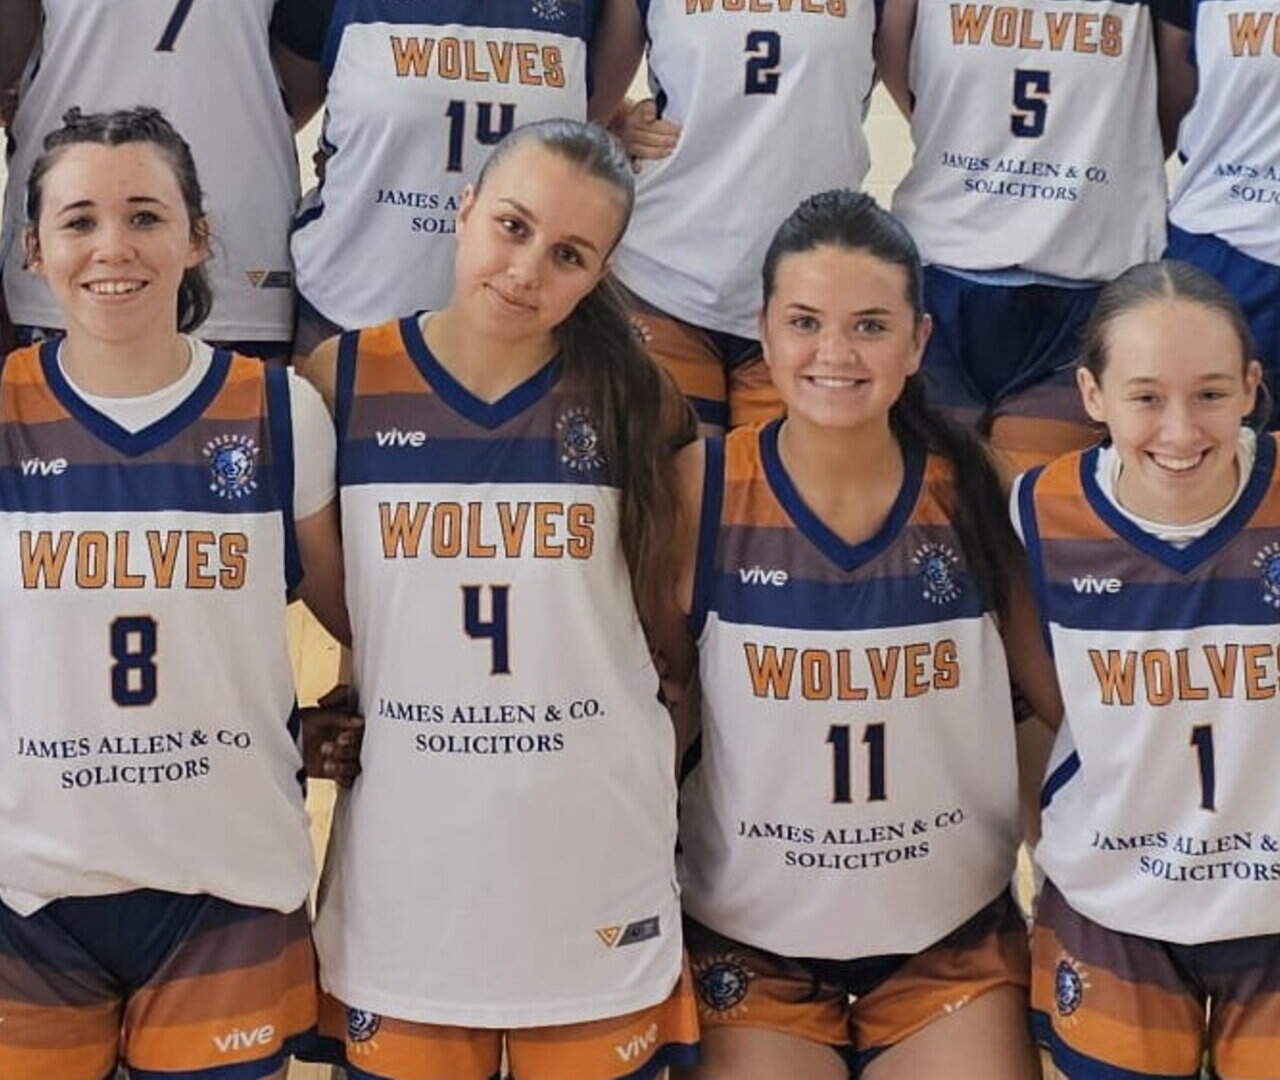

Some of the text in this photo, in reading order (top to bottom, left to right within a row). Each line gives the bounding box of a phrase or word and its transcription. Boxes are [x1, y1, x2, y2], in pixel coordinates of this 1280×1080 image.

[950, 3, 1123, 57] WOLVES
[390, 35, 566, 88] WOLVES
[745, 30, 781, 95] 2
[1010, 69, 1051, 138] 5
[941, 151, 1109, 184] JAMES ALLEN & CO.
[375, 189, 438, 210] JAMES
[963, 179, 1078, 201] SOLICITORS
[375, 429, 426, 447] vive
[21, 455, 68, 476] vive
[378, 502, 596, 560] WOLVES
[19, 530, 249, 589] WOLVES
[739, 566, 789, 586] vive
[1073, 574, 1122, 595] vive
[460, 584, 511, 676] 4
[110, 615, 158, 708] 8
[743, 639, 960, 701] WOLVES
[379, 699, 605, 724] JAMES ALLEN & CO.
[18, 737, 91, 759] JAMES
[98, 731, 184, 754] ALLEN
[190, 729, 208, 747] &
[415, 734, 564, 754] SOLICITORS
[61, 757, 210, 789] SOLICITORS
[825, 722, 887, 804] 11
[1190, 724, 1216, 813] 1
[738, 821, 814, 844] JAMES
[822, 822, 905, 845] ALLEN
[912, 820, 928, 834] &
[1092, 831, 1168, 852] JAMES
[1172, 832, 1252, 856] ALLEN
[1261, 836, 1278, 852] &
[785, 842, 930, 869] SOLICITORS
[214, 1022, 274, 1055] vive
